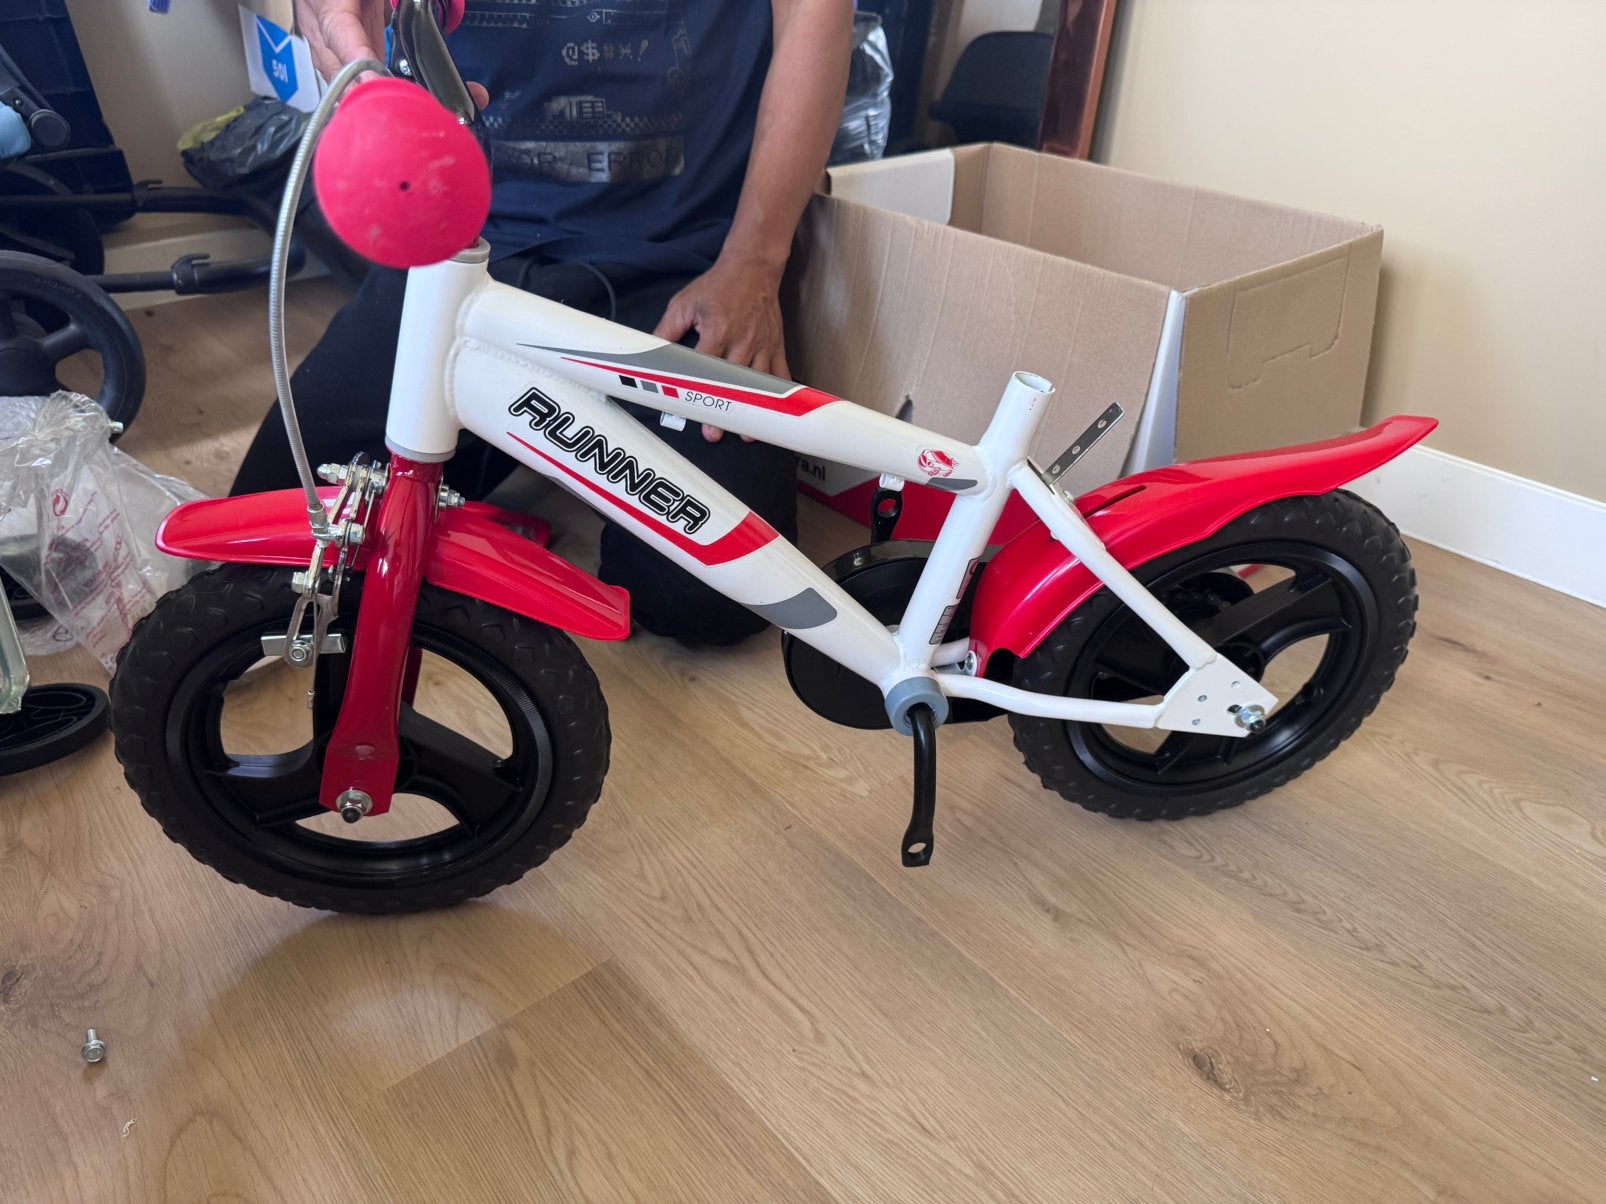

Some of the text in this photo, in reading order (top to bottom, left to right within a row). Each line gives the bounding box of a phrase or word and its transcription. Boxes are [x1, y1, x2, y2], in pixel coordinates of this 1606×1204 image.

[684, 390, 732, 412] SPORT
[508, 386, 711, 535] RUNNER
[796, 457, 826, 482] ra.nl
